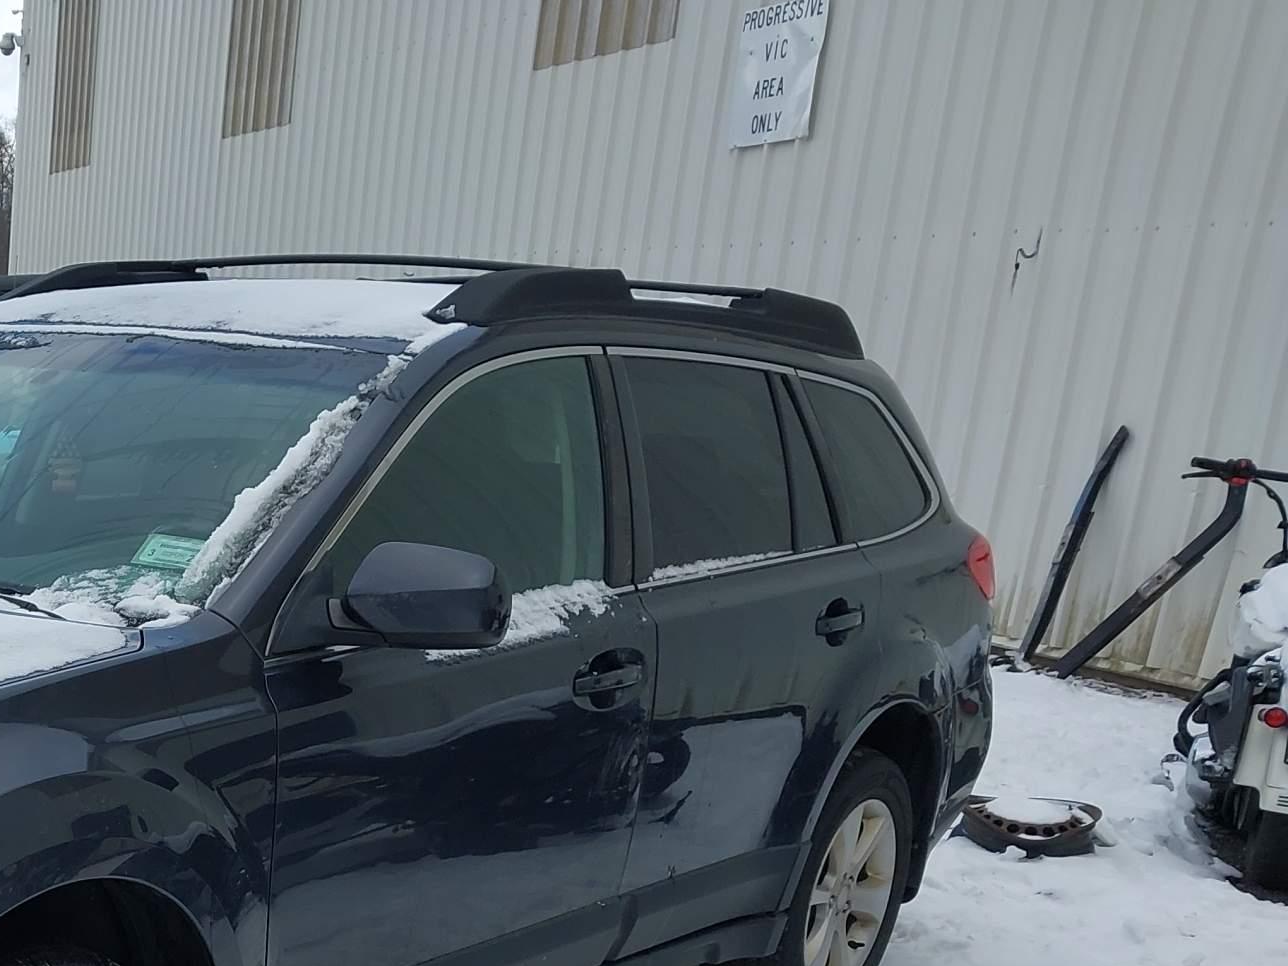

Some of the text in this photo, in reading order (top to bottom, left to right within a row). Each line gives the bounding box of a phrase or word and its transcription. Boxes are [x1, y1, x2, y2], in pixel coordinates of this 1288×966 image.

[743, 0, 824, 32] PROGRESSIVE
[765, 38, 789, 62] VIC
[753, 76, 784, 100] AREA
[751, 111, 782, 134] ONLY
